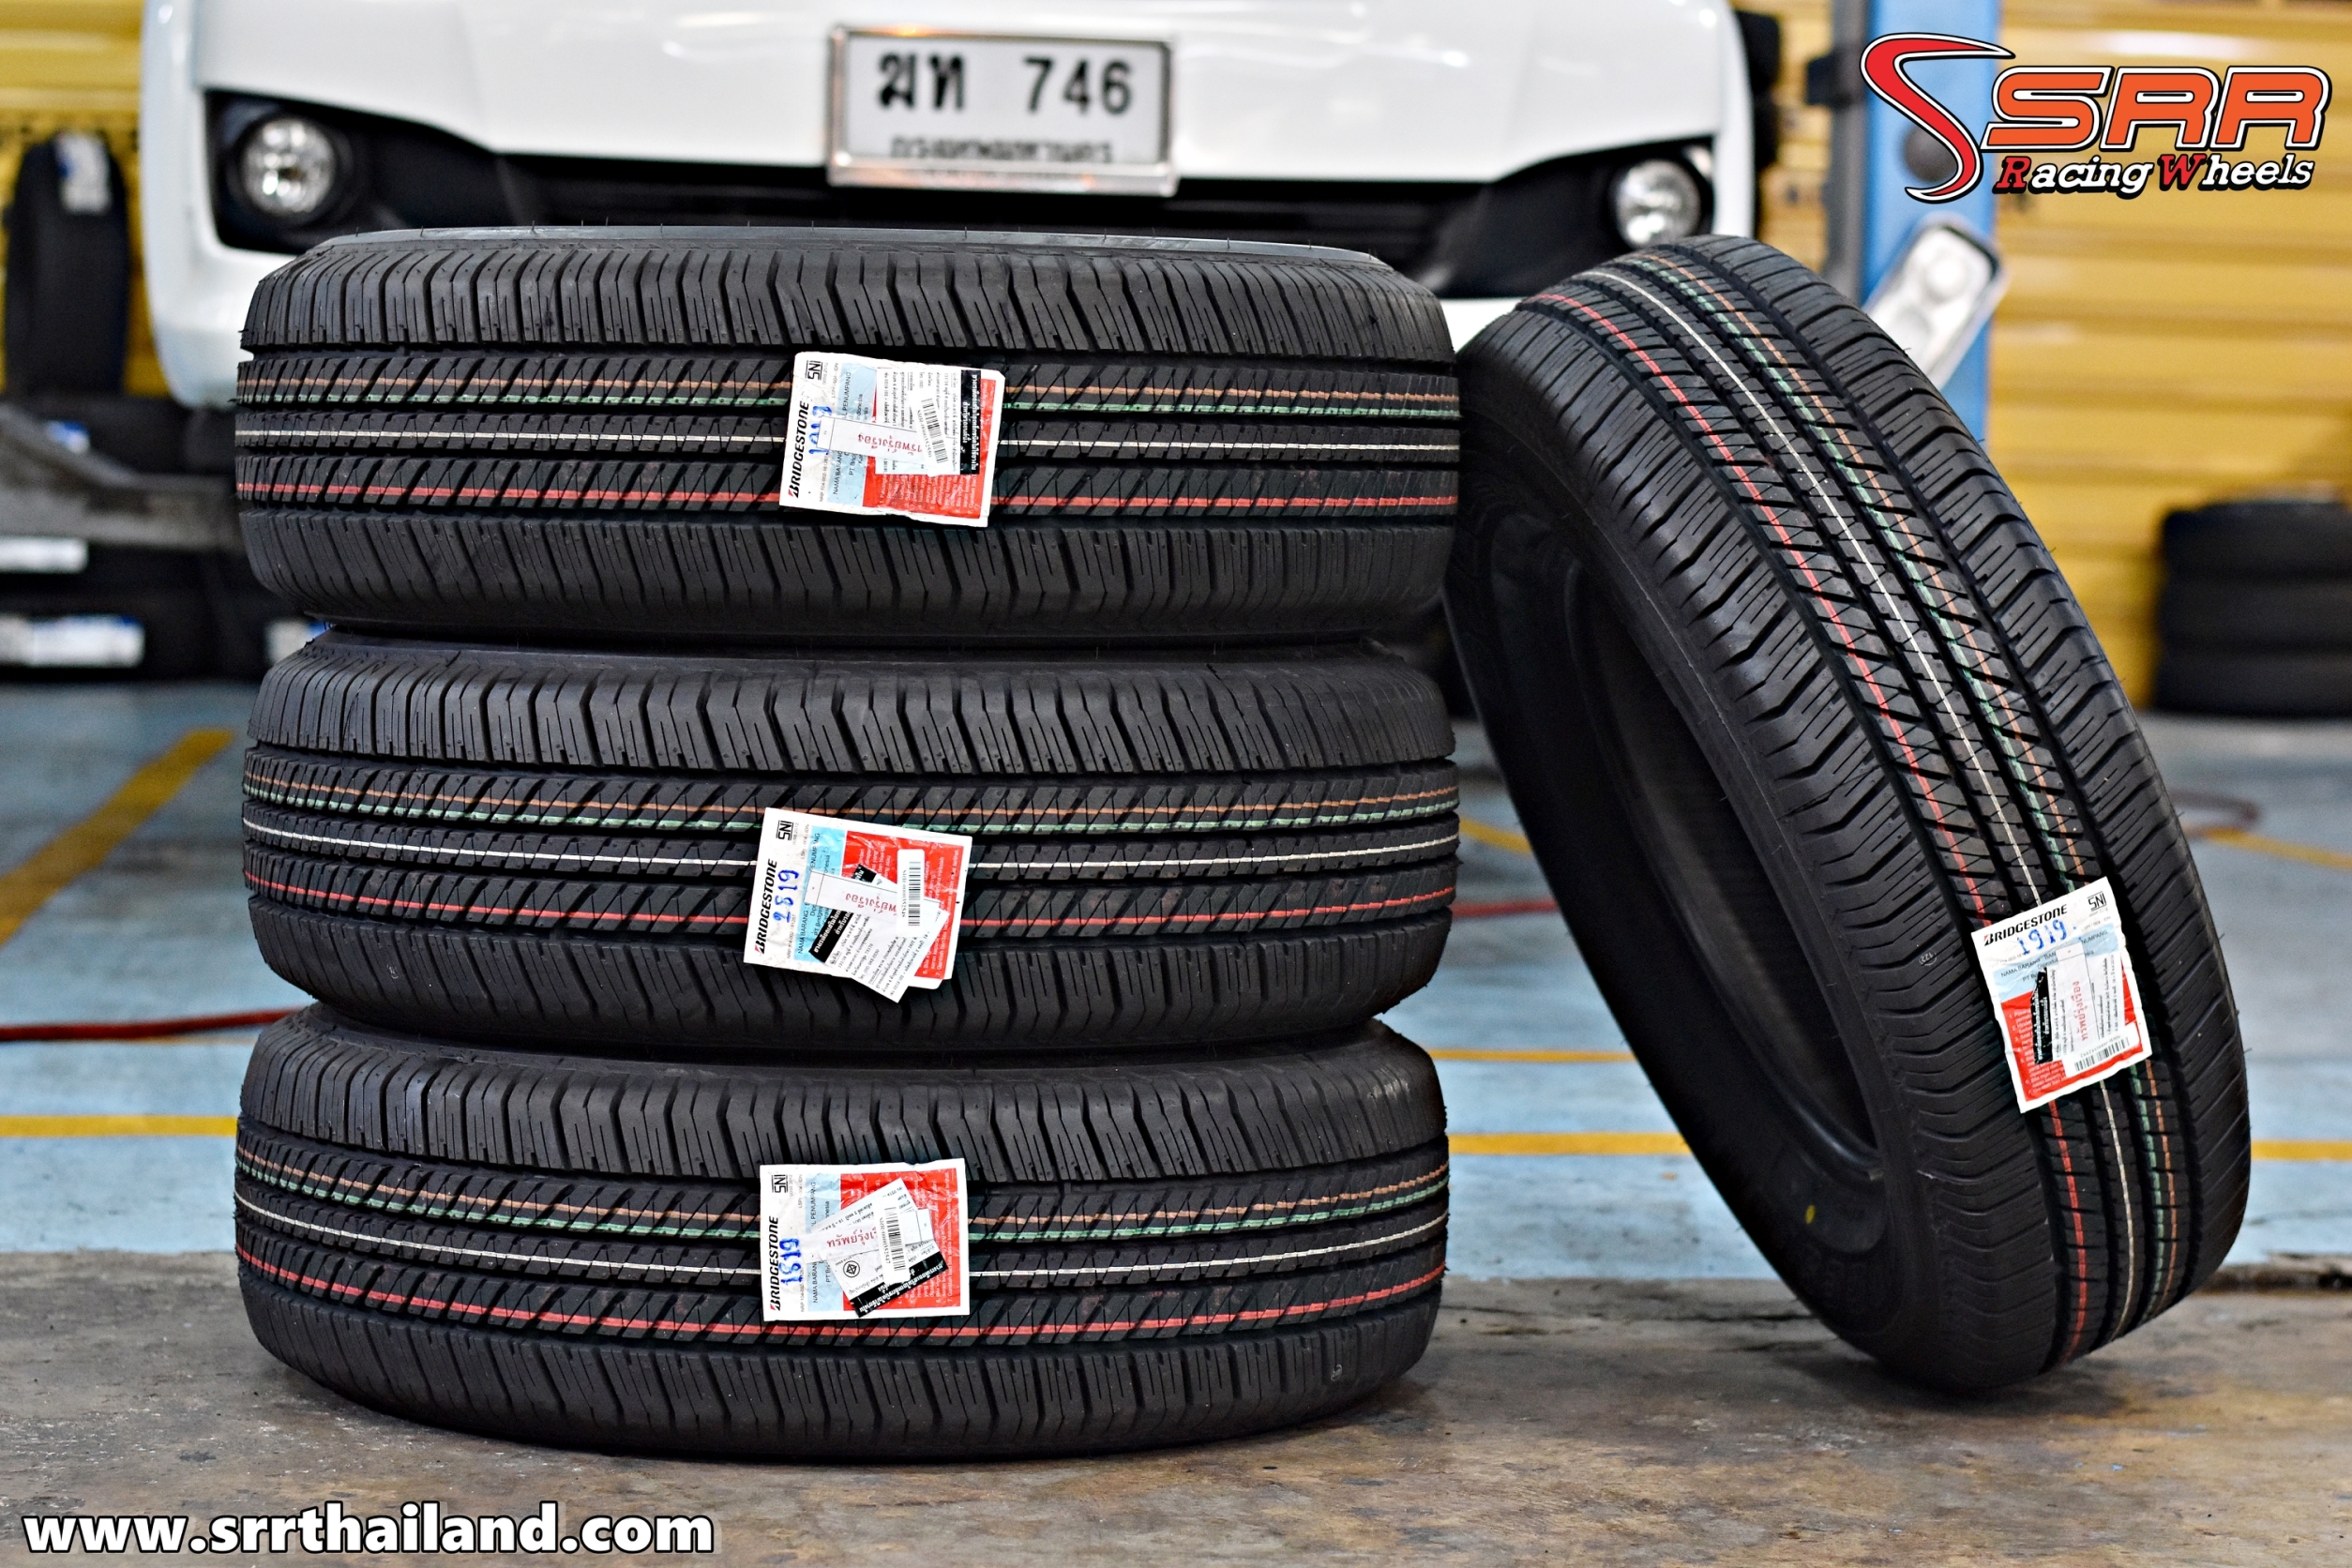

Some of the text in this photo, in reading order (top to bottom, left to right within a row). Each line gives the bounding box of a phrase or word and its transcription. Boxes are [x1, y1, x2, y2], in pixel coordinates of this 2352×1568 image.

[1022, 53, 1133, 114] 746
[807, 360, 822, 380] SNI
[842, 371, 852, 411] PENUMPANG
[788, 400, 810, 499] BRIDGESTONE
[777, 820, 793, 841] SNI
[754, 858, 777, 954] BRIDGESTONE
[773, 868, 800, 924] 2819
[1983, 892, 2107, 947] BRIDGESTONE SNI
[797, 936, 806, 954] NAMA
[800, 910, 809, 936] BARANG
[773, 1174, 787, 1193] SNI
[769, 1215, 780, 1311] BRIDGESTONE
[778, 1237, 803, 1286] 1819
